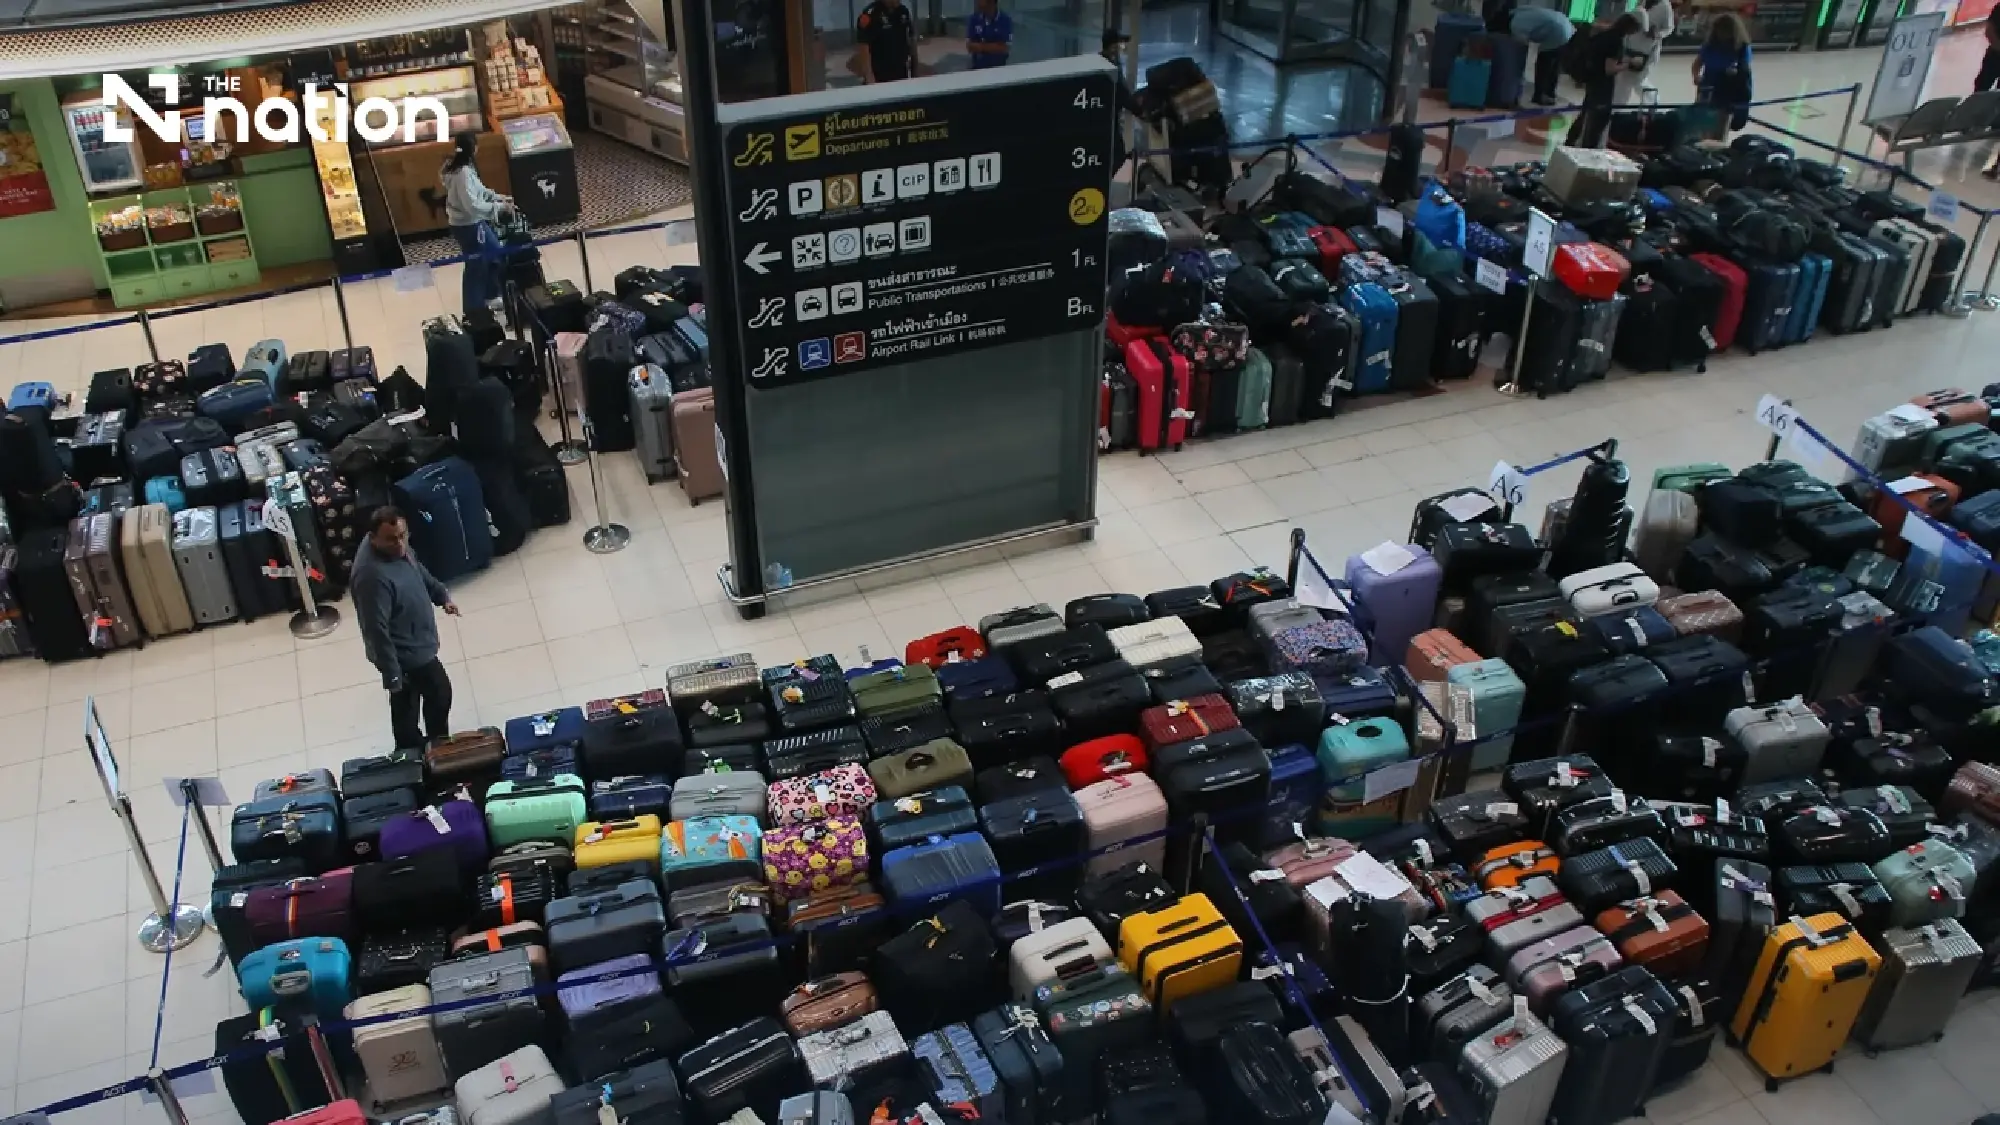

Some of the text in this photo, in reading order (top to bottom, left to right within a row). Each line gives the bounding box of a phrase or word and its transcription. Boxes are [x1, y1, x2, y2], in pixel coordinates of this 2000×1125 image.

[1891, 27, 1939, 51] OUT
[825, 138, 890, 156] Departures
[902, 173, 926, 187] CIP
[797, 188, 813, 209] P
[868, 281, 987, 309] Public Transportations
[870, 310, 969, 339] รถไฟฟ้าเข้าเมือง
[871, 333, 956, 358] Airport Rail Link
[1761, 405, 1789, 431] A6
[1490, 473, 1524, 505] A6
[102, 1085, 127, 1098] AOT
